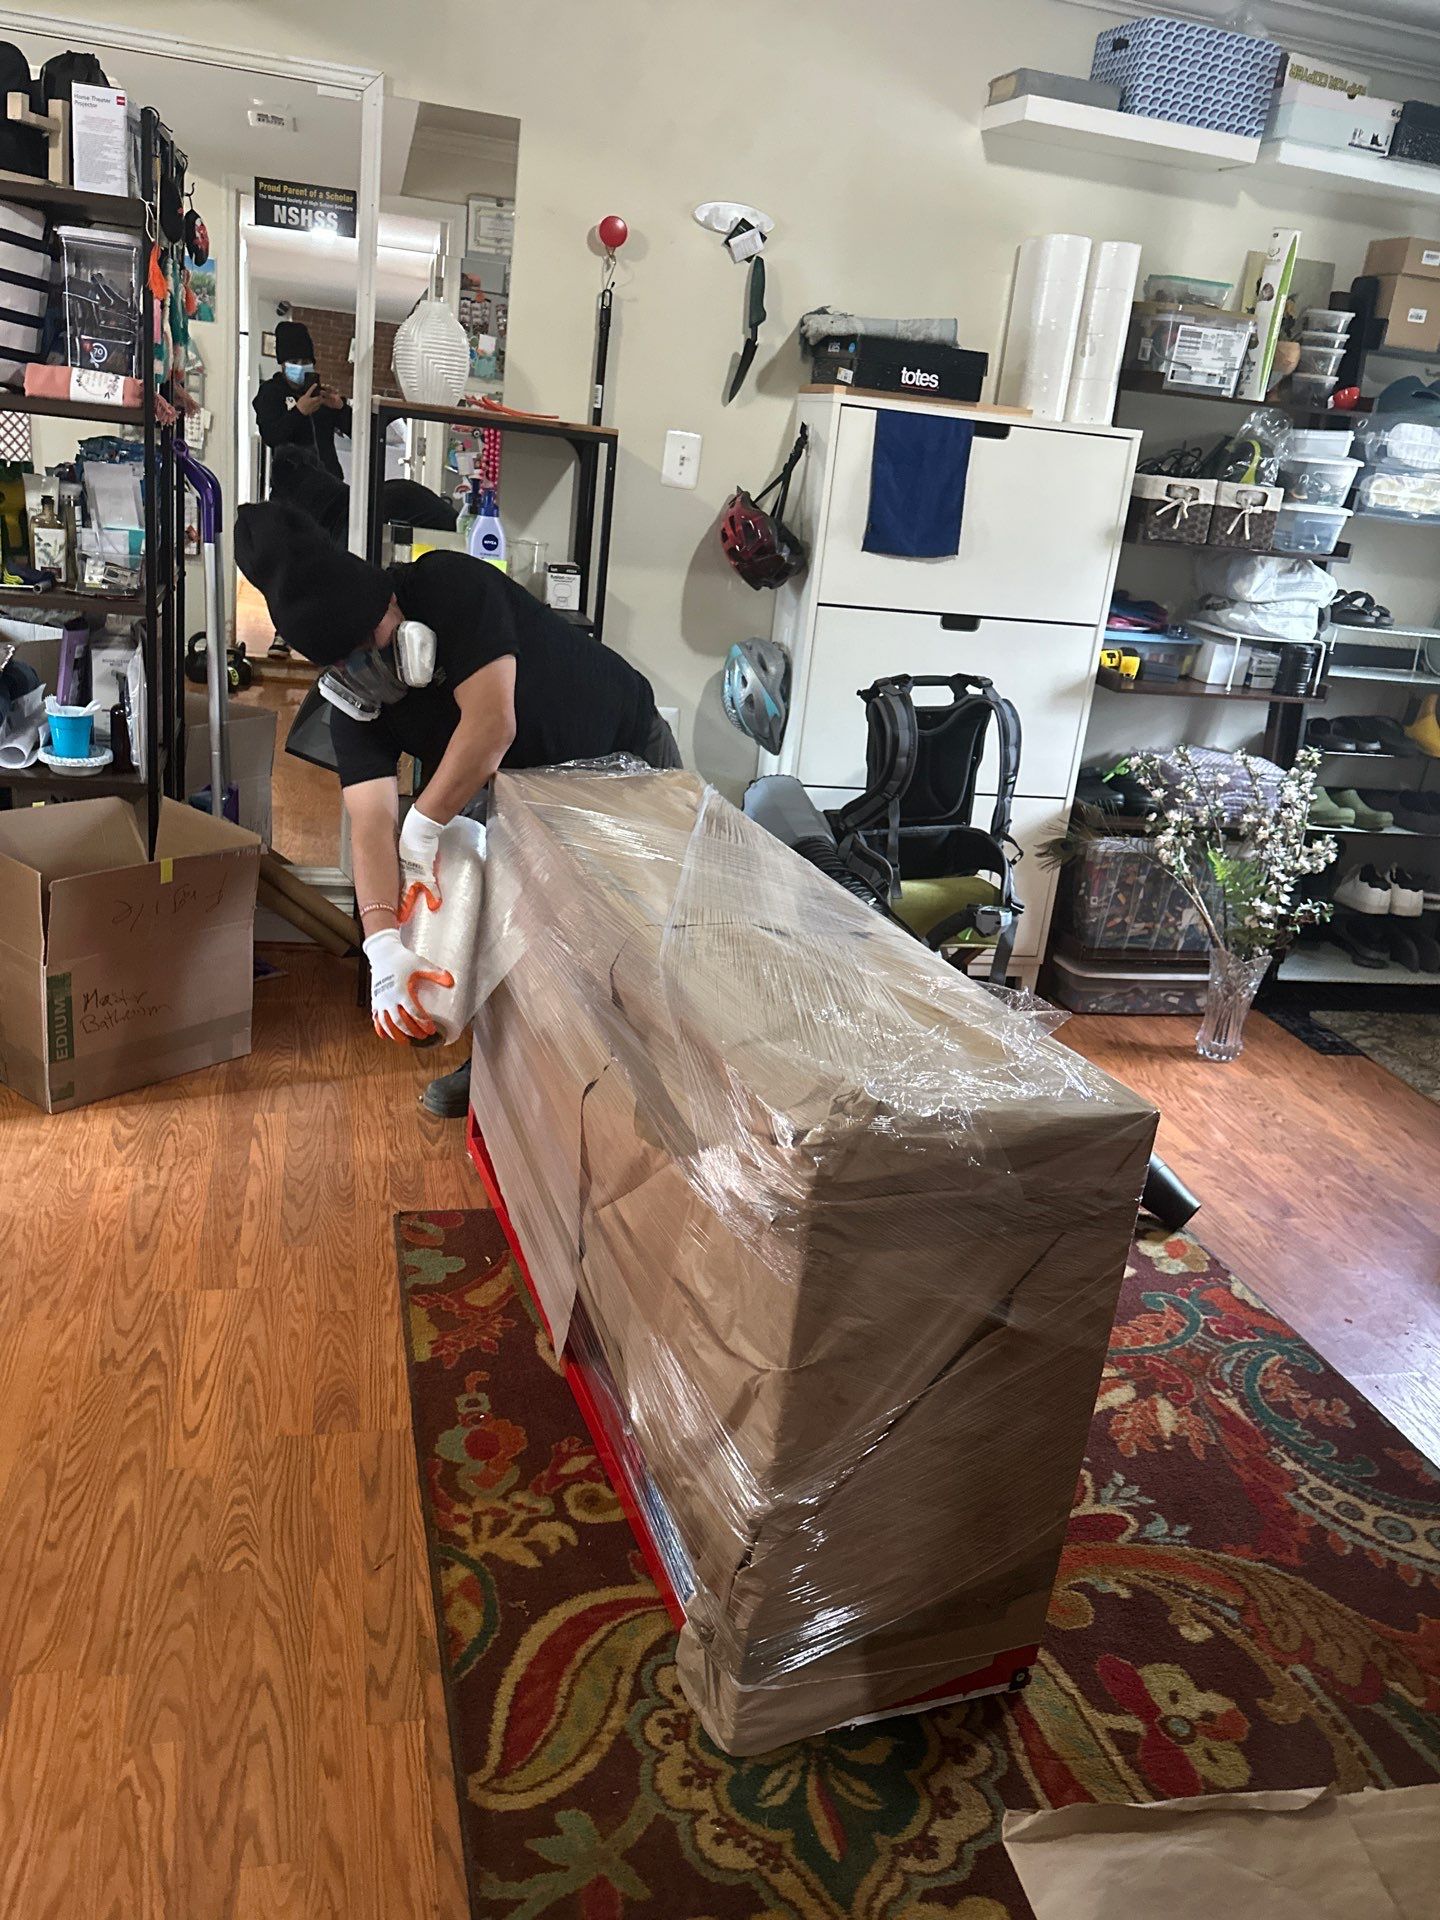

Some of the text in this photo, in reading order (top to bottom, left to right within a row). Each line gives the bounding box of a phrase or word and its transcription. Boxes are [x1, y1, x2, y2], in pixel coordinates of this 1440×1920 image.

[74, 100, 98, 108] Projector
[91, 95, 111, 103] Theater
[259, 182, 281, 193] Proud
[283, 185, 308, 197] Parent
[309, 189, 318, 198] of
[325, 191, 354, 203] Scholar
[273, 204, 338, 231] NSHSS
[901, 366, 939, 388] totes
[54, 998, 69, 1060] EDIUM
